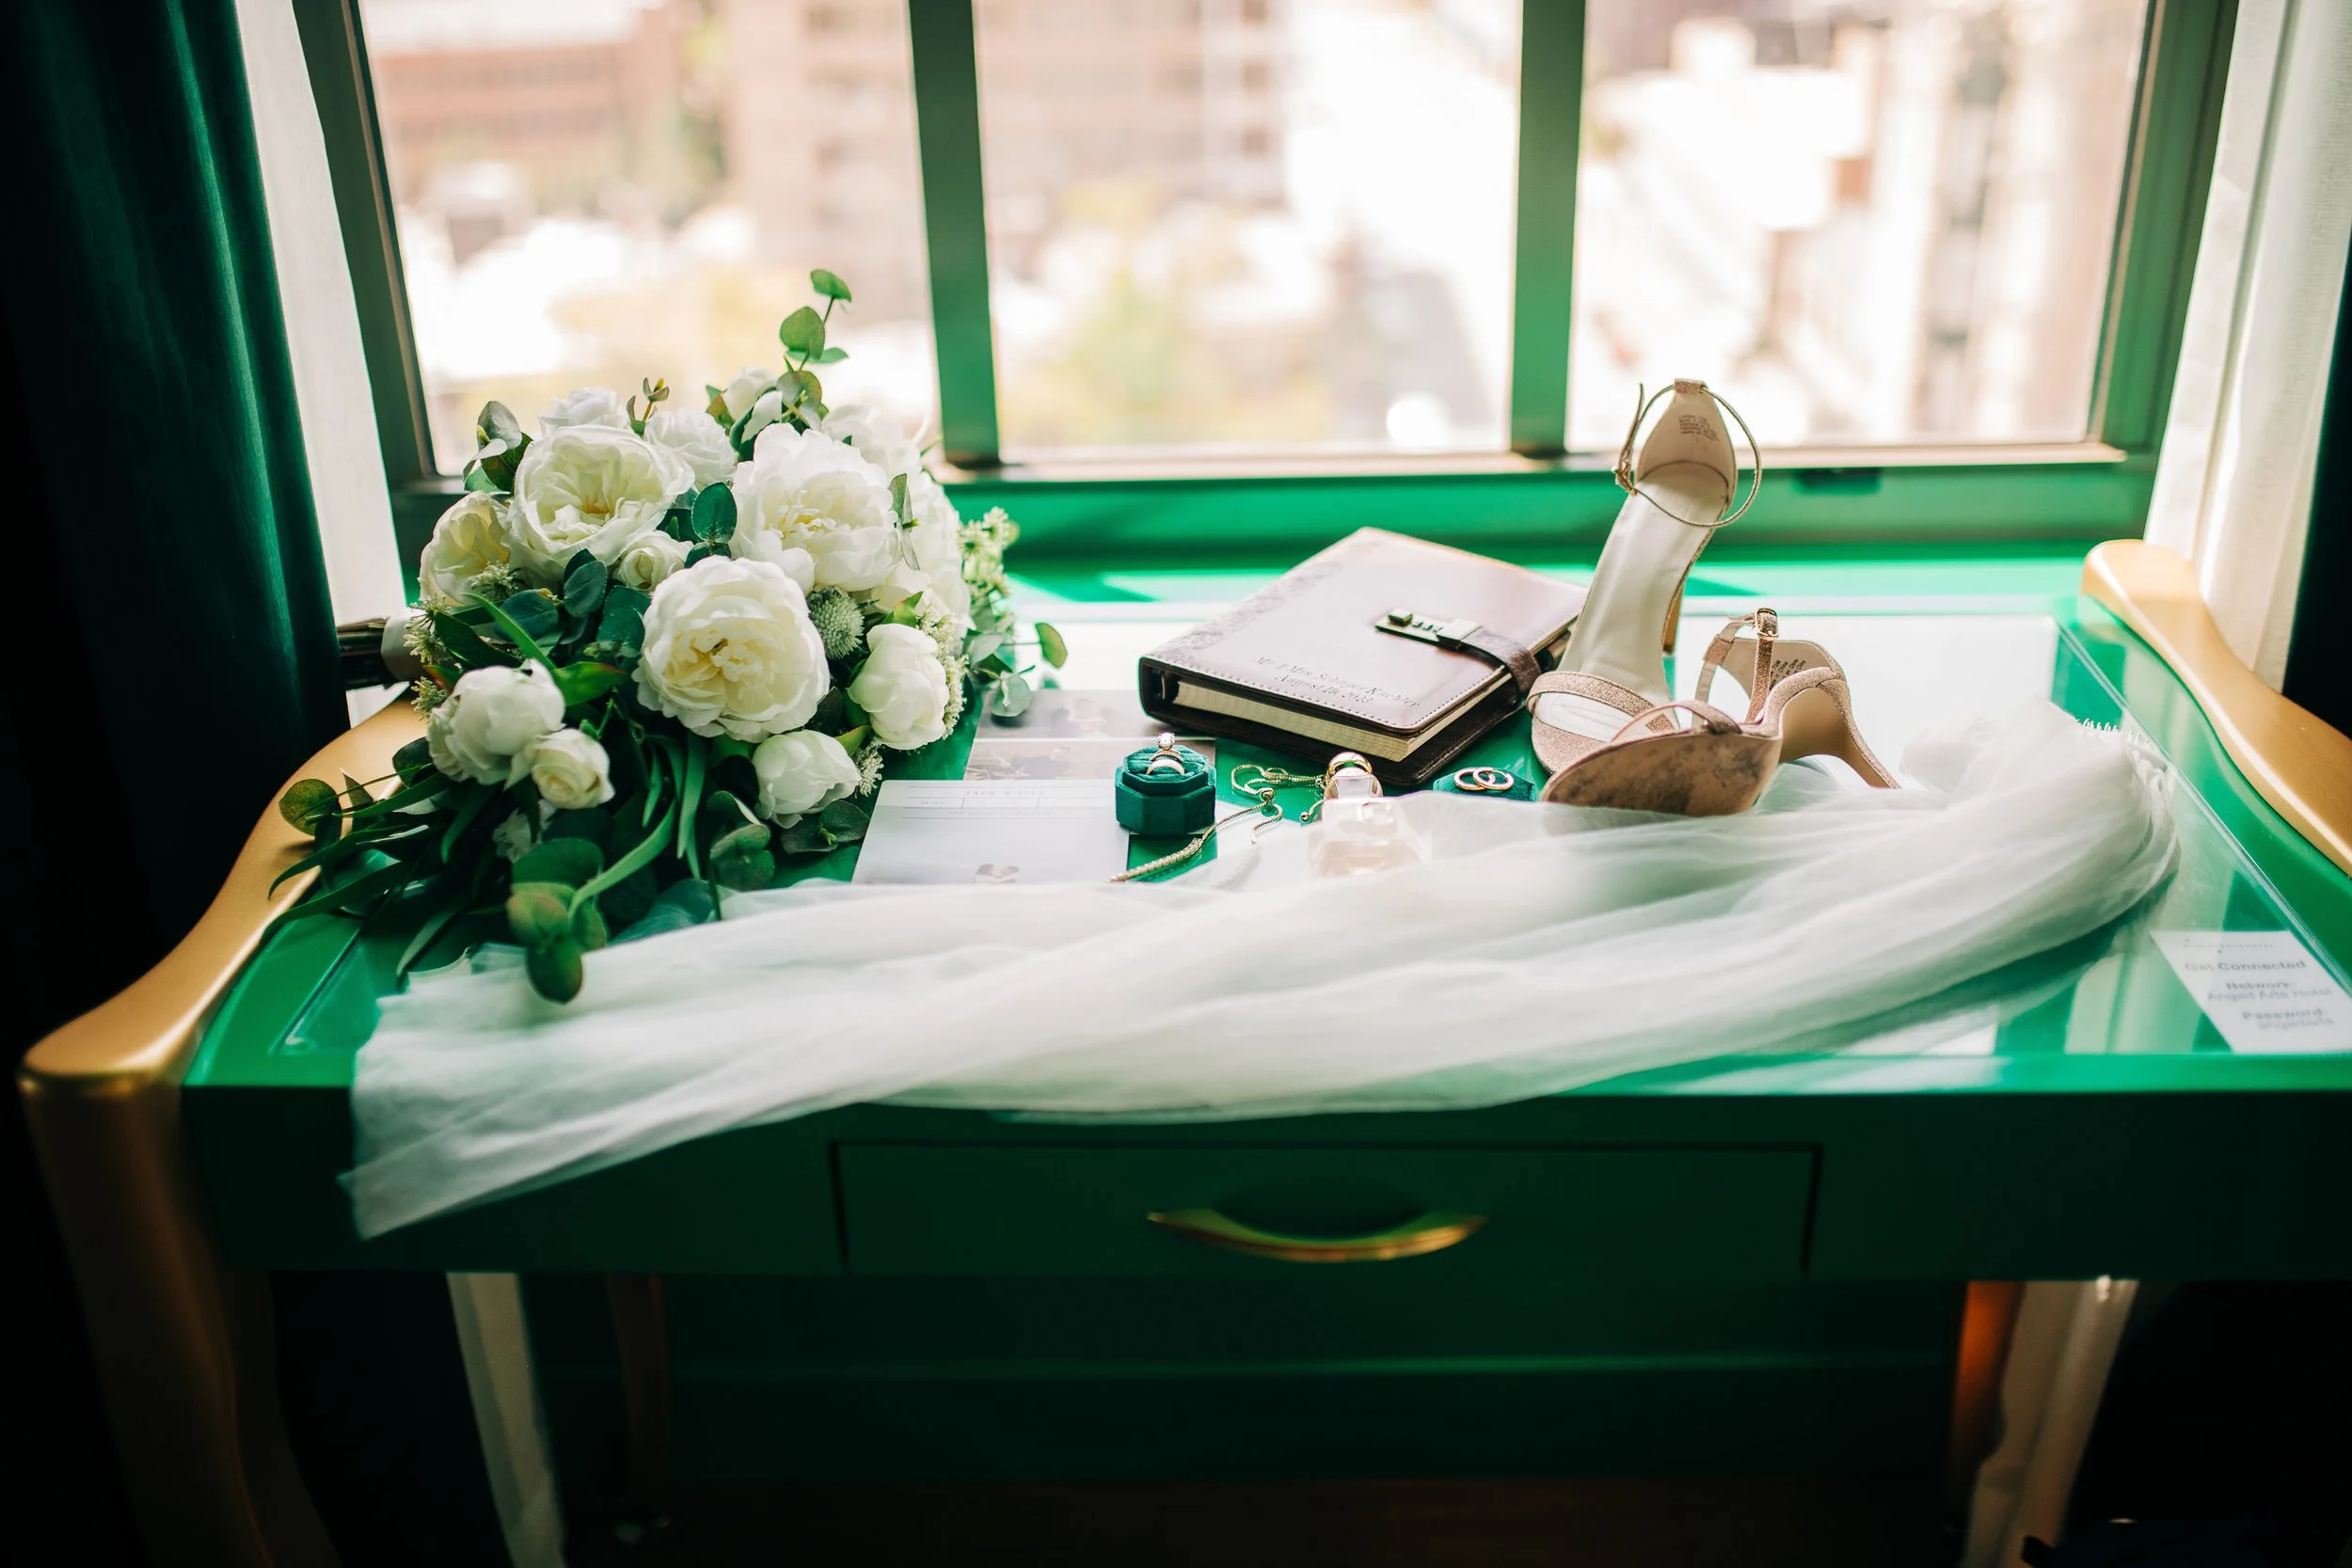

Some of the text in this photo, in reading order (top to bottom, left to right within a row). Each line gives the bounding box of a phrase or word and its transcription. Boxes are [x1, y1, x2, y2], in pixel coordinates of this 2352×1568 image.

[2185, 959, 2307, 972] Get Connected
[2292, 987, 2334, 998] Hotel
